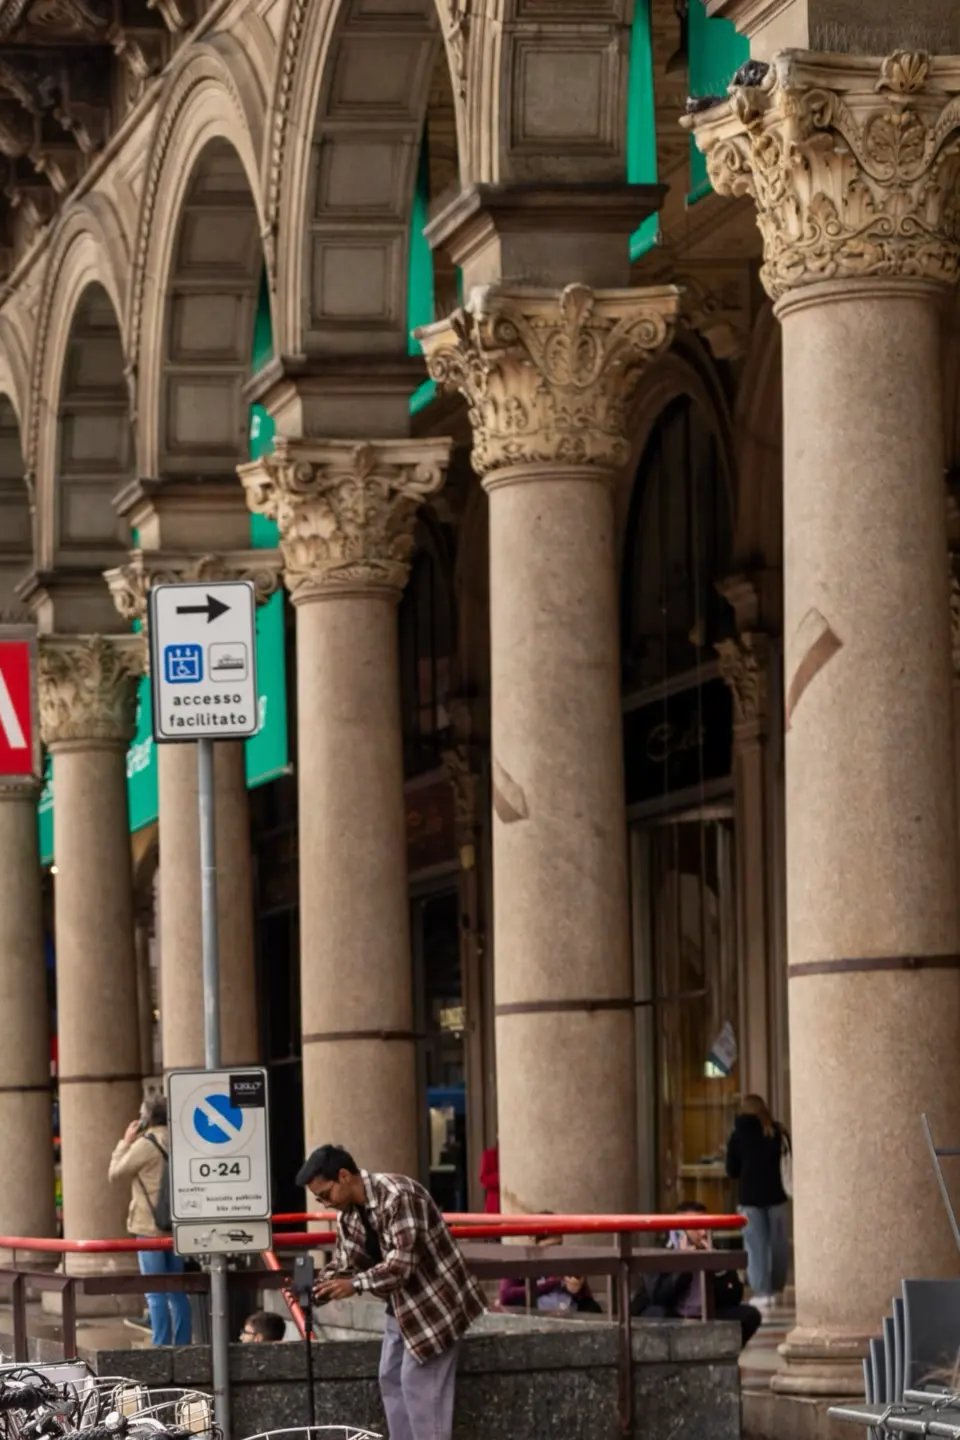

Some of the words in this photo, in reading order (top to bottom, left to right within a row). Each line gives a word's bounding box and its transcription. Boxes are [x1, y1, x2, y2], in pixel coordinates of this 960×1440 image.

[173, 693, 242, 706] accesso
[169, 712, 247, 727] facilitato
[199, 1162, 241, 1177] 0-24
